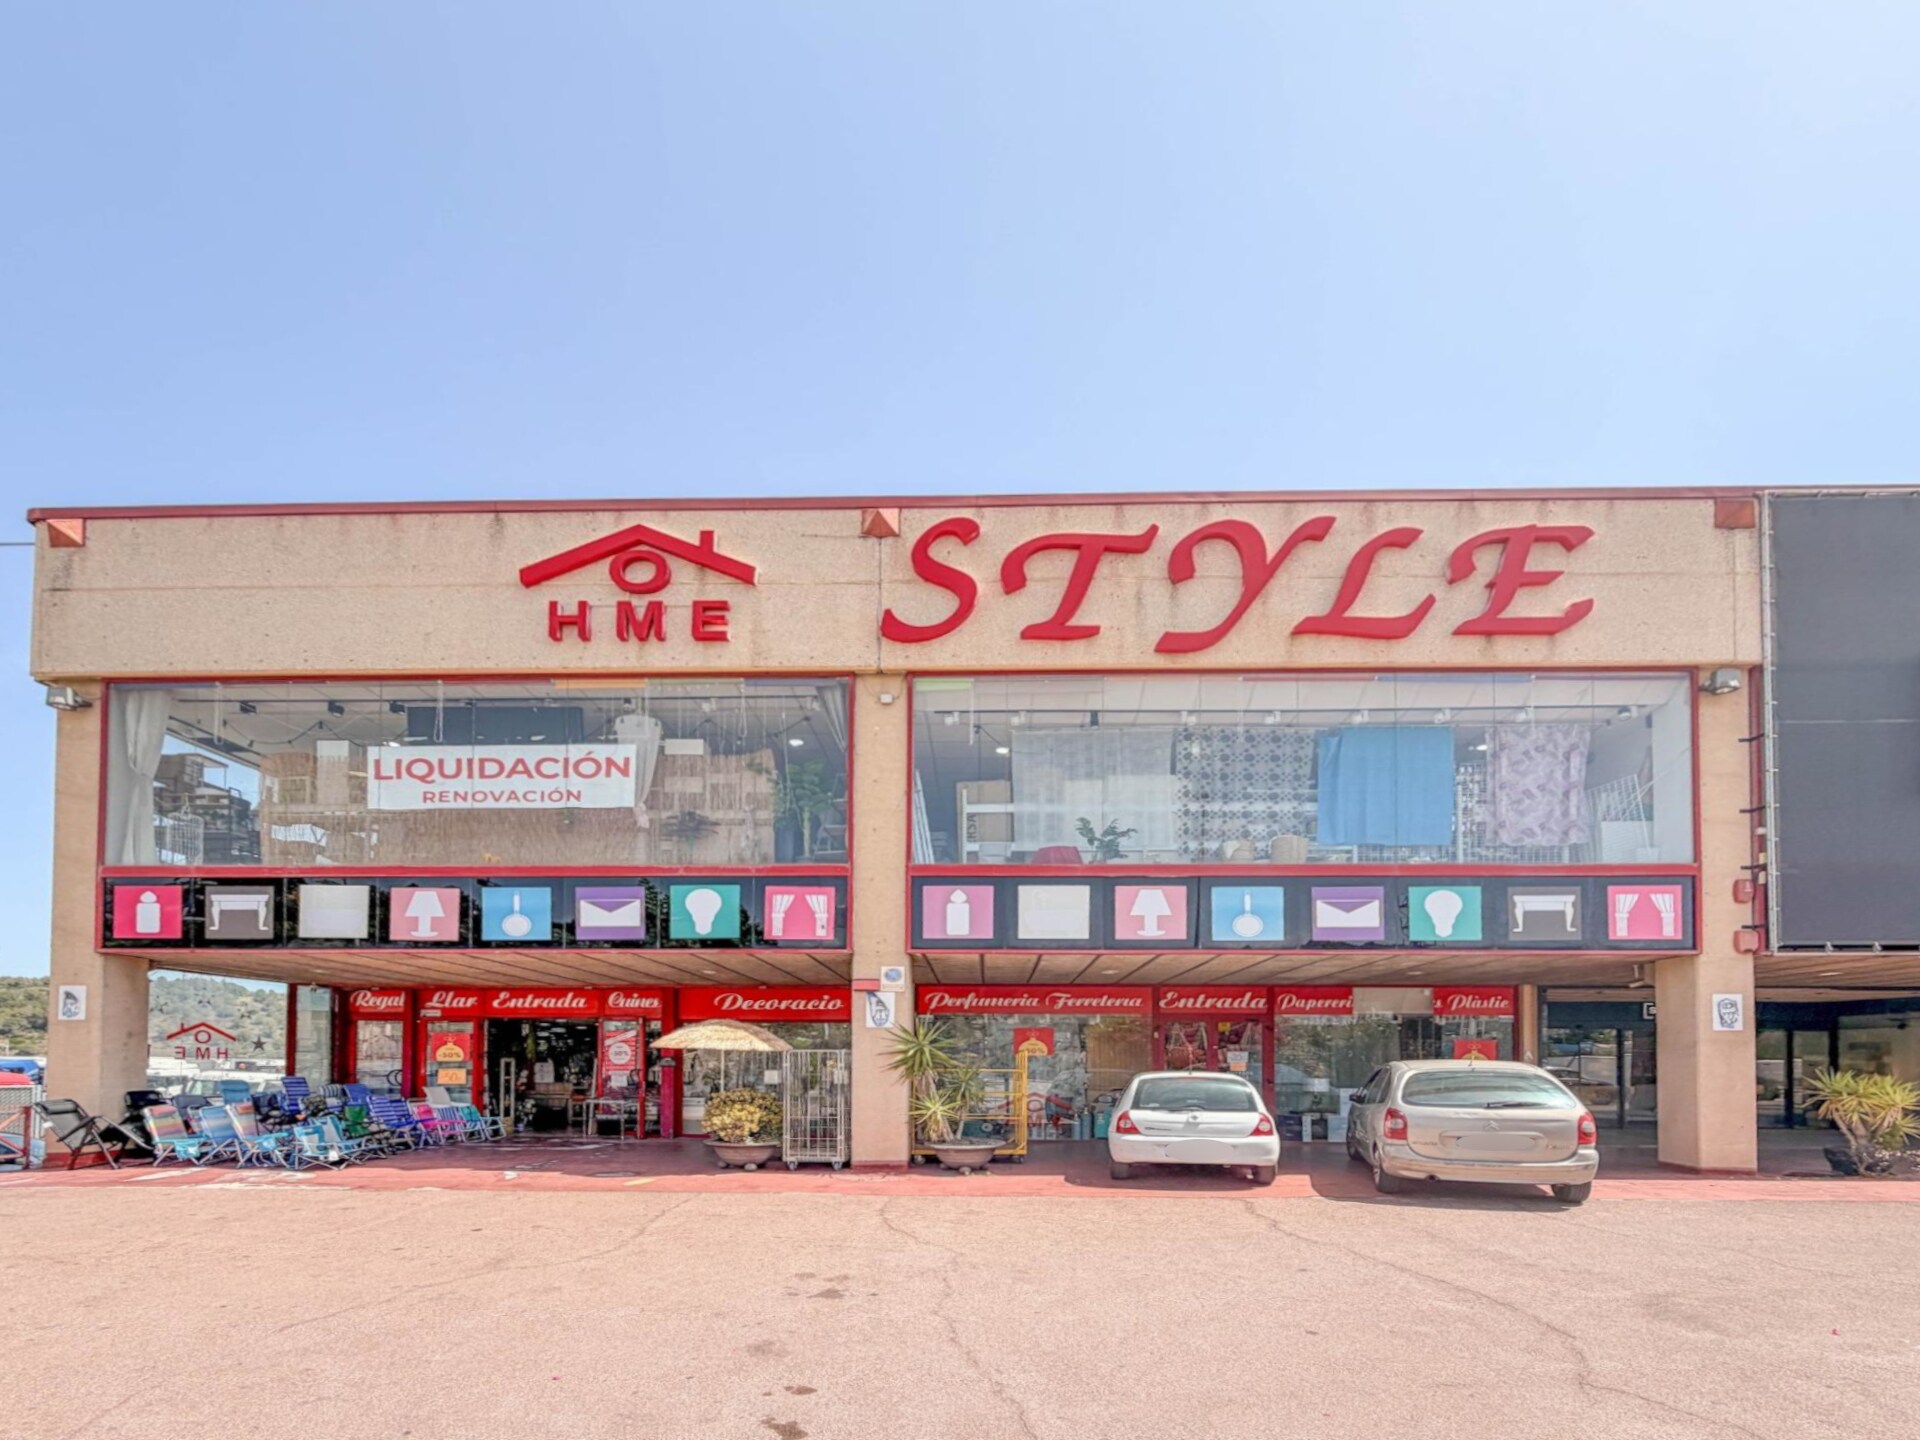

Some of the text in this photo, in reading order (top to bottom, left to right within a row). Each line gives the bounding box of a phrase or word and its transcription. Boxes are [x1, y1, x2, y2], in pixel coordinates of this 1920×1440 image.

[881, 515, 1595, 655] STYLE
[372, 751, 632, 784] LIQUIDACIÓN
[422, 787, 583, 804] RENOVACIÓN
[350, 989, 405, 1010] Regal
[424, 990, 478, 1008] Llar
[491, 990, 588, 1009] Entrada
[1158, 991, 1268, 1010] Entrada
[1277, 992, 1353, 1011] Papereri
